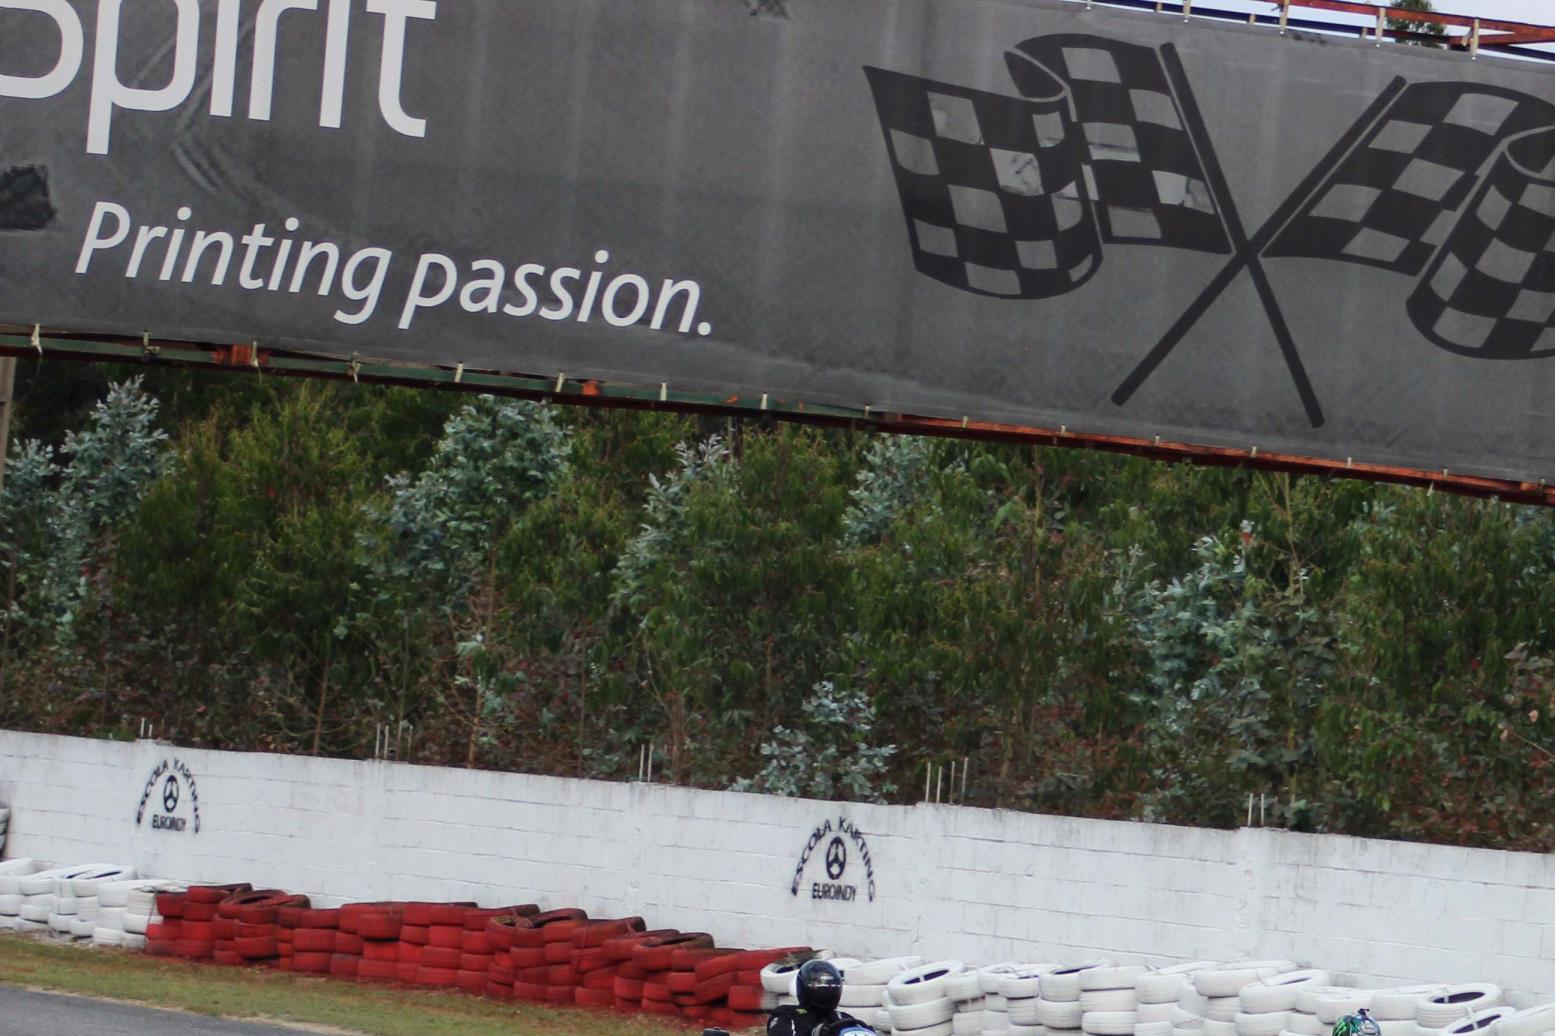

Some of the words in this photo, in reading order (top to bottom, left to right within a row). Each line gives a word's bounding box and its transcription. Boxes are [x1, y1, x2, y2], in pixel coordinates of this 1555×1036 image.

[76, 202, 392, 325] Printing
[399, 250, 711, 336] passion.
[791, 819, 831, 896] ESCOLA
[812, 882, 857, 901] EUROINDY
